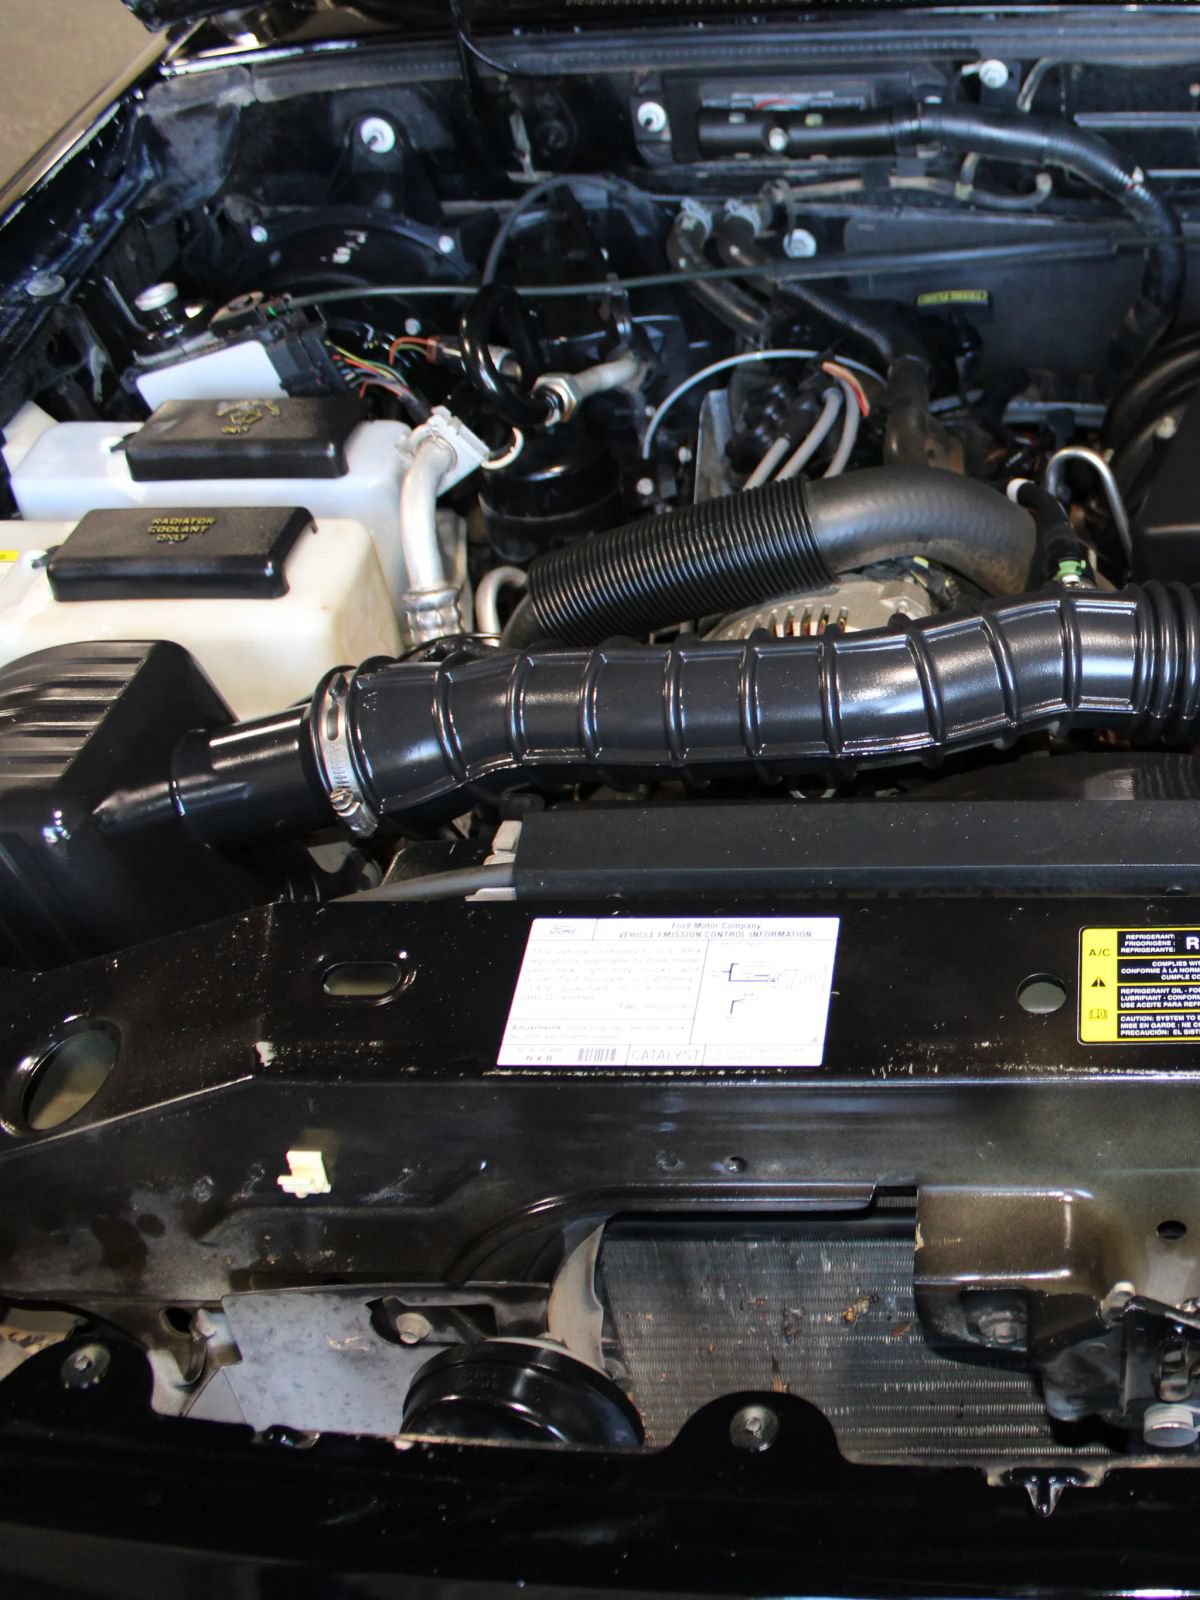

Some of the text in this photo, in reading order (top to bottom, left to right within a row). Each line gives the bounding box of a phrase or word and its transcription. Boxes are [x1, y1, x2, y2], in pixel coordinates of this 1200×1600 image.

[156, 534, 189, 542] ONLY
[722, 922, 761, 931] Company
[1089, 948, 1110, 956] A/C
[632, 1049, 701, 1061] CATALYST
